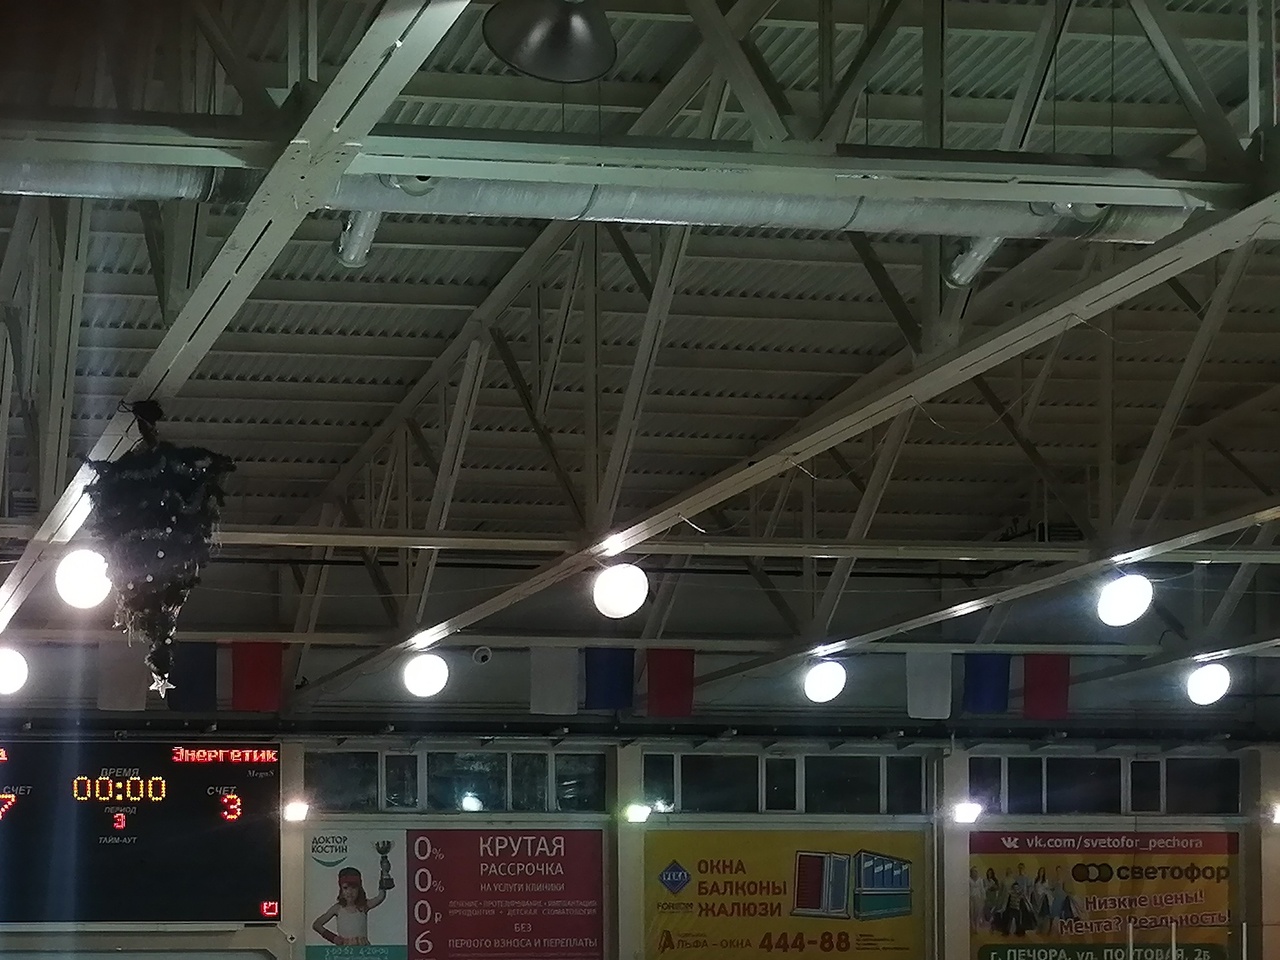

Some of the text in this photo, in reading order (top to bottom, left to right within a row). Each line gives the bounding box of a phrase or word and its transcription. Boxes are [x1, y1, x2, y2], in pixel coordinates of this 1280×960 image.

[172, 747, 278, 762] Энергетик
[100, 768, 139, 777] ВРЕМЯ
[2, 786, 32, 796] СЧЕТ
[73, 776, 166, 801] 00:00
[207, 786, 236, 796] СЧЕТ
[220, 794, 242, 821] 3
[112, 813, 126, 830] 3
[311, 835, 348, 845] ДОКТОР
[479, 835, 565, 858] КРУТАЯ
[1026, 836, 1203, 851] vk.com/svetofor_pechora
[311, 845, 348, 854] КОСТИН
[414, 836, 445, 861] 0%
[479, 862, 565, 877] РАССРОЧКА
[697, 859, 747, 875] ОКНА
[1116, 863, 1230, 884] светофор
[414, 867, 445, 893] 0%
[697, 880, 787, 896] БАЛКОНЫ
[1085, 888, 1205, 912] Низкие цены!
[697, 902, 782, 918] ЖАЛЮЗИ
[514, 922, 532, 933] БЕЗ
[1059, 915, 1122, 935] Мечта?
[414, 930, 433, 953] 6
[448, 937, 598, 949] ПЕРВОГО ВЗНОСА И ПЕРЕПЛАТЫ
[758, 931, 851, 953] 444-88
